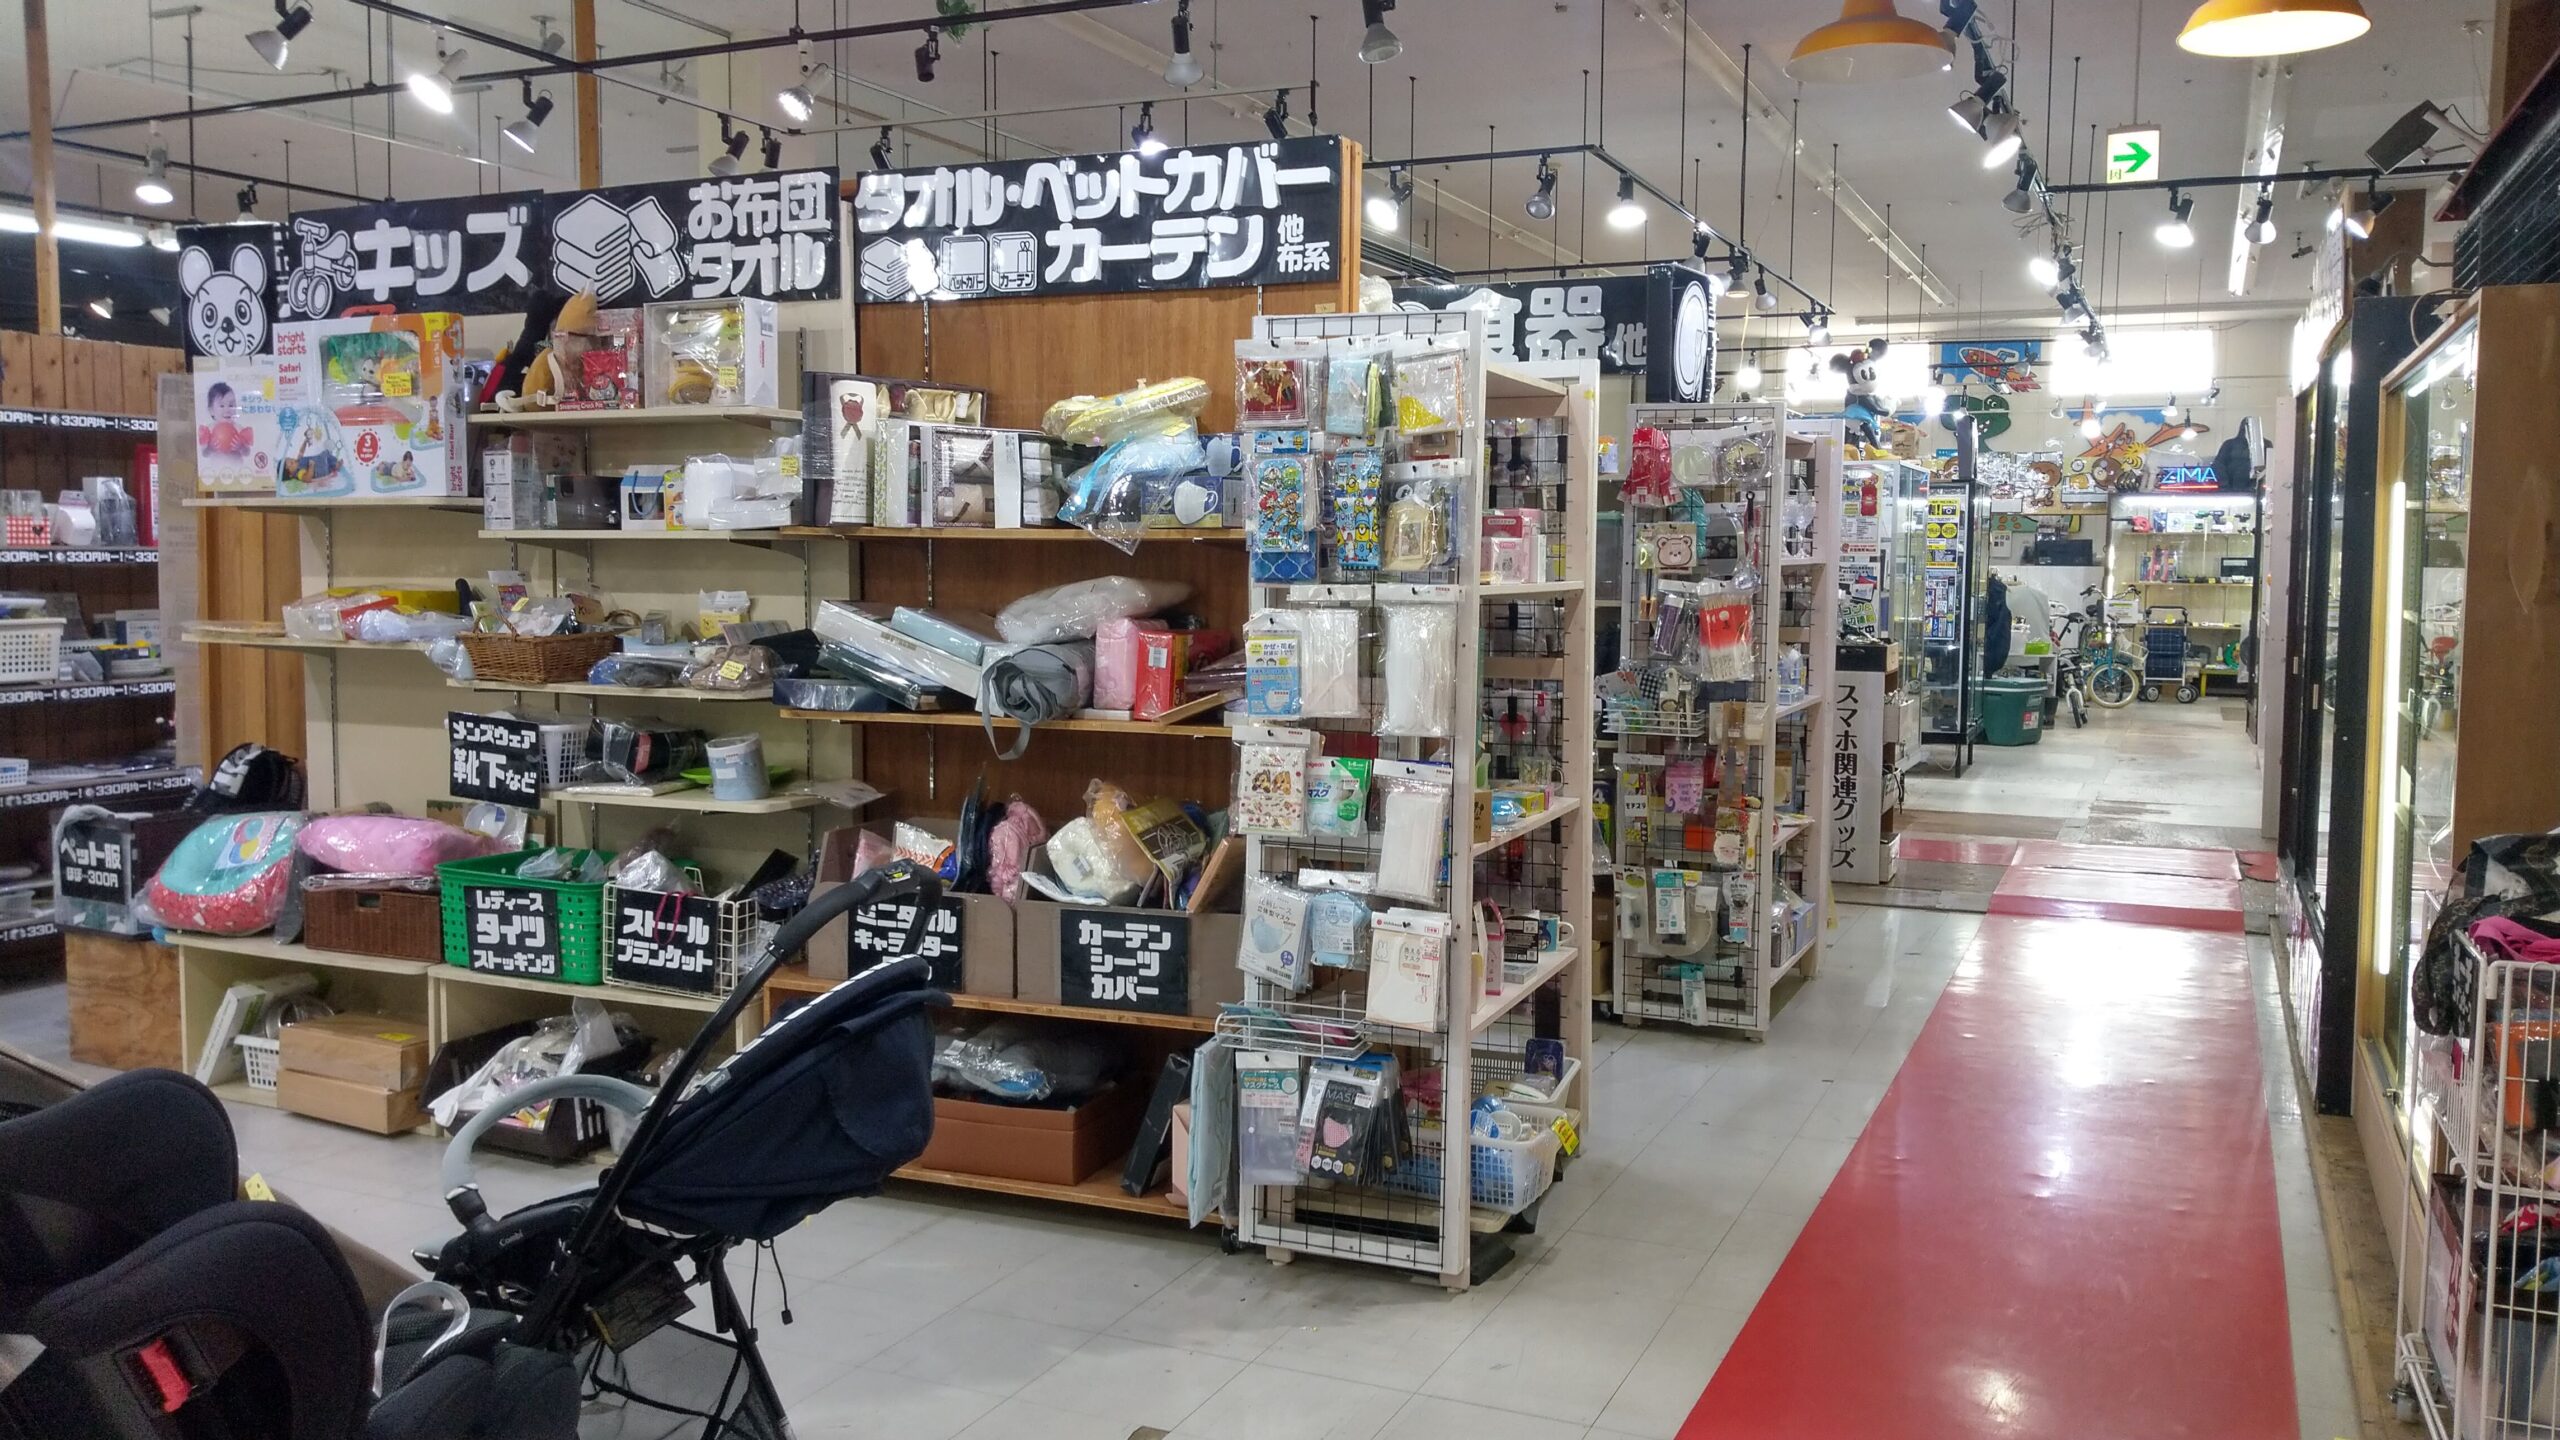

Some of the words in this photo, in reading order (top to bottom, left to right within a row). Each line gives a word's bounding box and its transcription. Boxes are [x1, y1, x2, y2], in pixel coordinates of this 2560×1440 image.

[688, 171, 832, 239] お布団
[353, 204, 533, 301] キッズ
[1046, 214, 1267, 283] カーテン
[1277, 214, 1305, 245] 他
[1277, 240, 1331, 274] 布系
[689, 232, 826, 299] タオル
[1000, 273, 1034, 287] カーテン
[278, 331, 305, 345] bright
[278, 344, 307, 356] starts
[279, 362, 301, 373] Safari
[279, 376, 298, 384] Blast
[130, 419, 158, 431] 330
[2161, 466, 2218, 484] ZIMA
[139, 681, 176, 694] 330円
[453, 720, 536, 750] メンズウェア
[163, 776, 192, 788] 330
[453, 747, 536, 794] 靴下など
[1832, 684, 1860, 869] スマホ関連グッズ
[60, 837, 122, 870] ペット服
[475, 889, 545, 913] レディース
[27, 923, 58, 938] 330
[476, 913, 546, 948] タイツ
[622, 907, 710, 946] ストール
[1078, 918, 1172, 951] カーテン
[618, 938, 713, 974] ブランケット
[854, 928, 959, 957] キャラター
[472, 949, 555, 975] ストッキング
[1090, 947, 1160, 977] シーツ
[1091, 973, 1160, 1002] カバー
